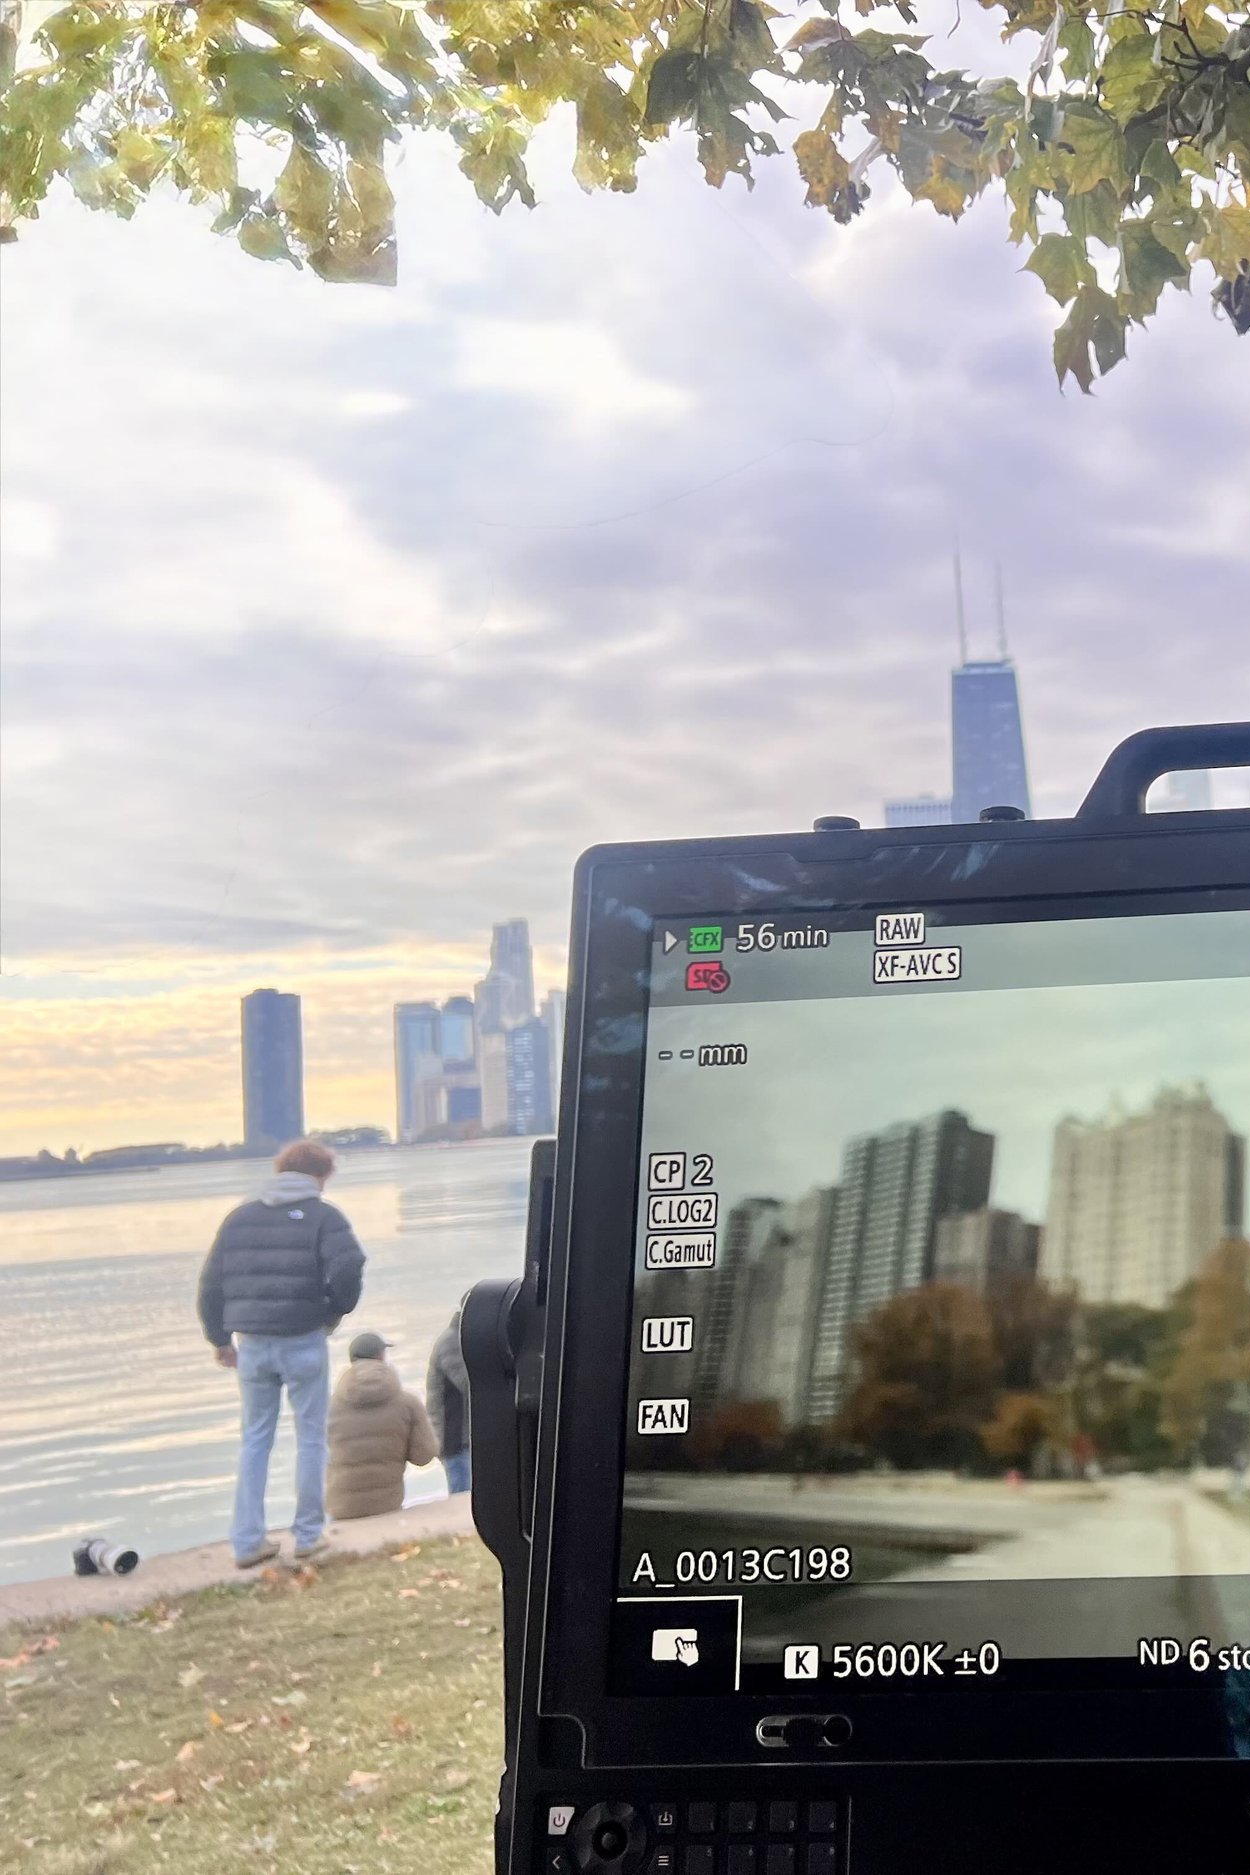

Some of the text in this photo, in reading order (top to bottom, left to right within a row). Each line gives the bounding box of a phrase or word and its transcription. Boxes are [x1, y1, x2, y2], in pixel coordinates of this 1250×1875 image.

[692, 923, 829, 951] CFX 56 min
[879, 917, 922, 941] RAW
[877, 951, 958, 979] XF-AVC S
[653, 1154, 714, 1186] CP 2
[651, 1199, 713, 1224] C.LOG2
[649, 1239, 713, 1264] C.Gamut
[646, 1320, 690, 1349] LUT
[640, 1404, 686, 1430] FAN
[632, 1547, 851, 1587] A_0013C198
[832, 1643, 945, 1678] 5600K
[953, 1642, 1001, 1676] ±0
[1139, 1639, 1180, 1666] ND
[1188, 1638, 1210, 1672] 6
